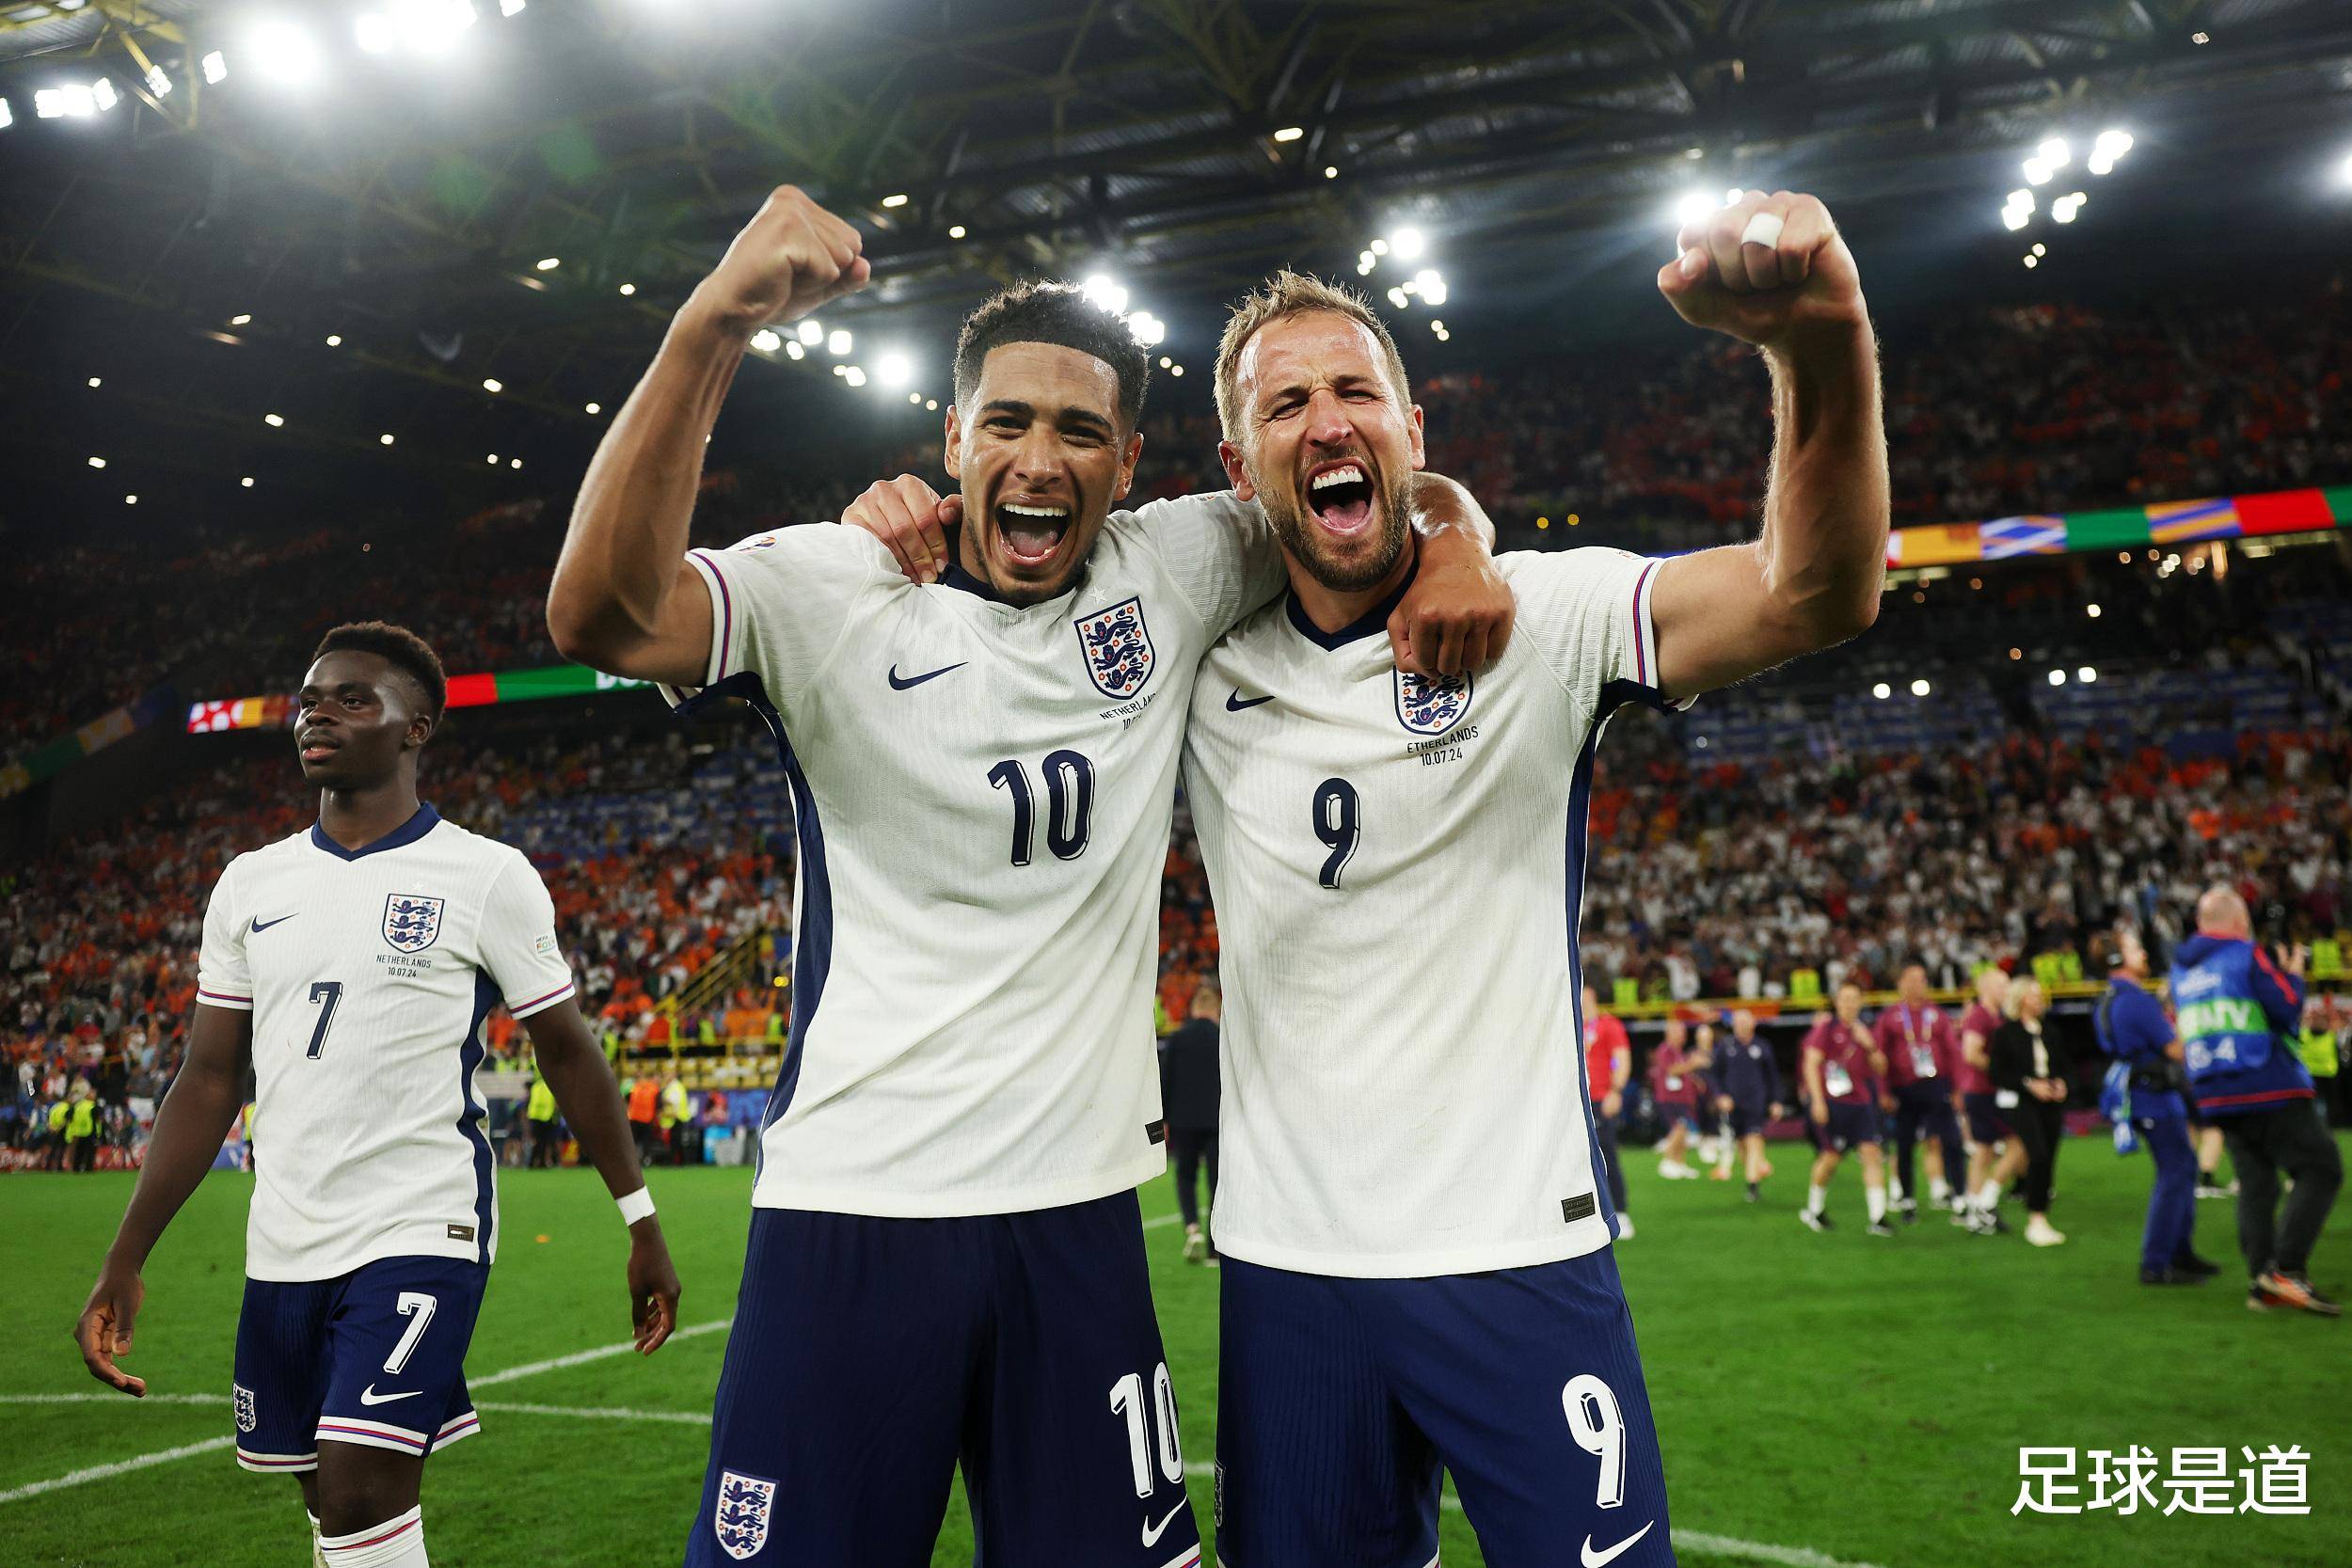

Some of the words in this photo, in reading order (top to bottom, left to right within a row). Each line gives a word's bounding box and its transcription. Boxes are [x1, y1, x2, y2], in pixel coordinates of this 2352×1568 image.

[1099, 692, 1157, 720] NETHERLAN
[1406, 725, 1479, 753] ETHERLANDS
[1421, 747, 1463, 767] 10.07.24
[987, 749, 1096, 866] 10
[1312, 777, 1360, 889] 9
[376, 954, 432, 969] NETHERLANDS
[388, 966, 417, 978] 10.07.24
[307, 981, 343, 1059] 7
[383, 1291, 437, 1374] 7
[1109, 1361, 1184, 1498] 10
[1562, 1373, 1627, 1510] 9
